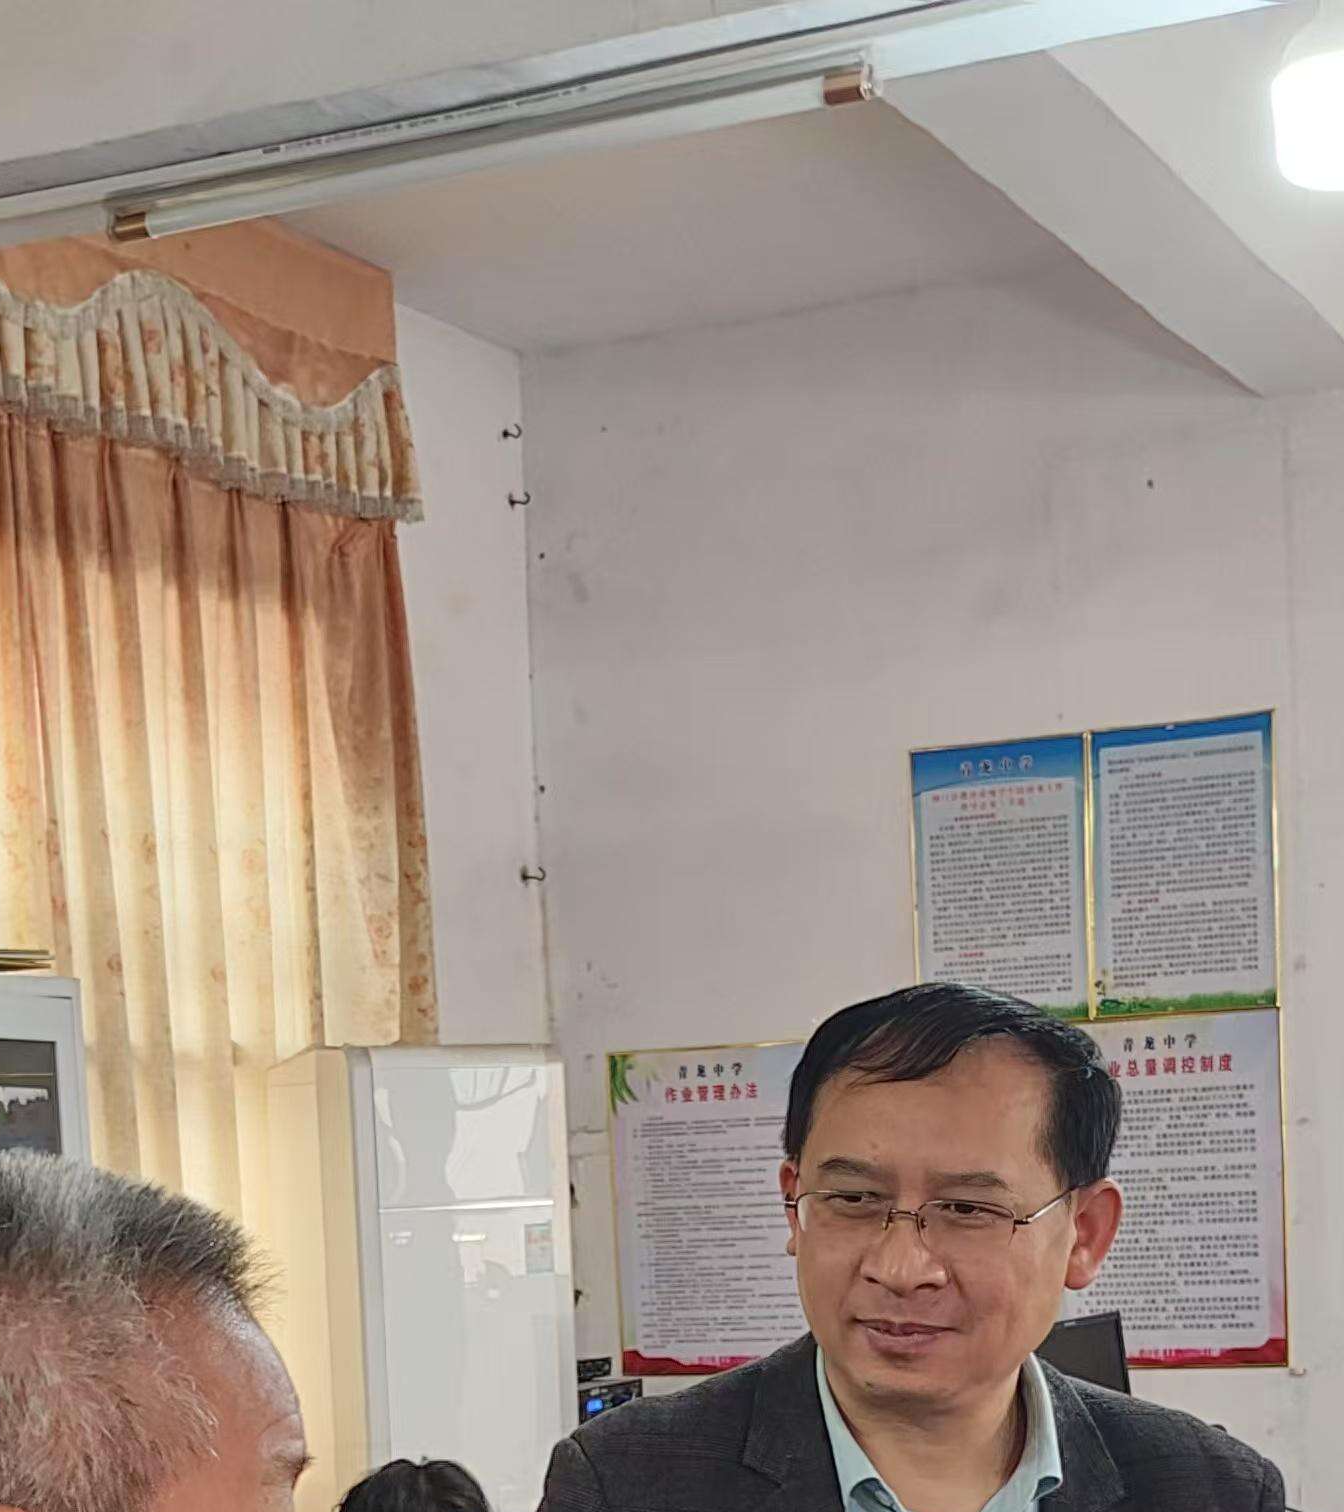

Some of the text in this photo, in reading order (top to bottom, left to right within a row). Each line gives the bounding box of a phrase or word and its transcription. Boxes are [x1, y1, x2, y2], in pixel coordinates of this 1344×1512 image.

[1108, 1054, 1233, 1078] 业总量调控制度
